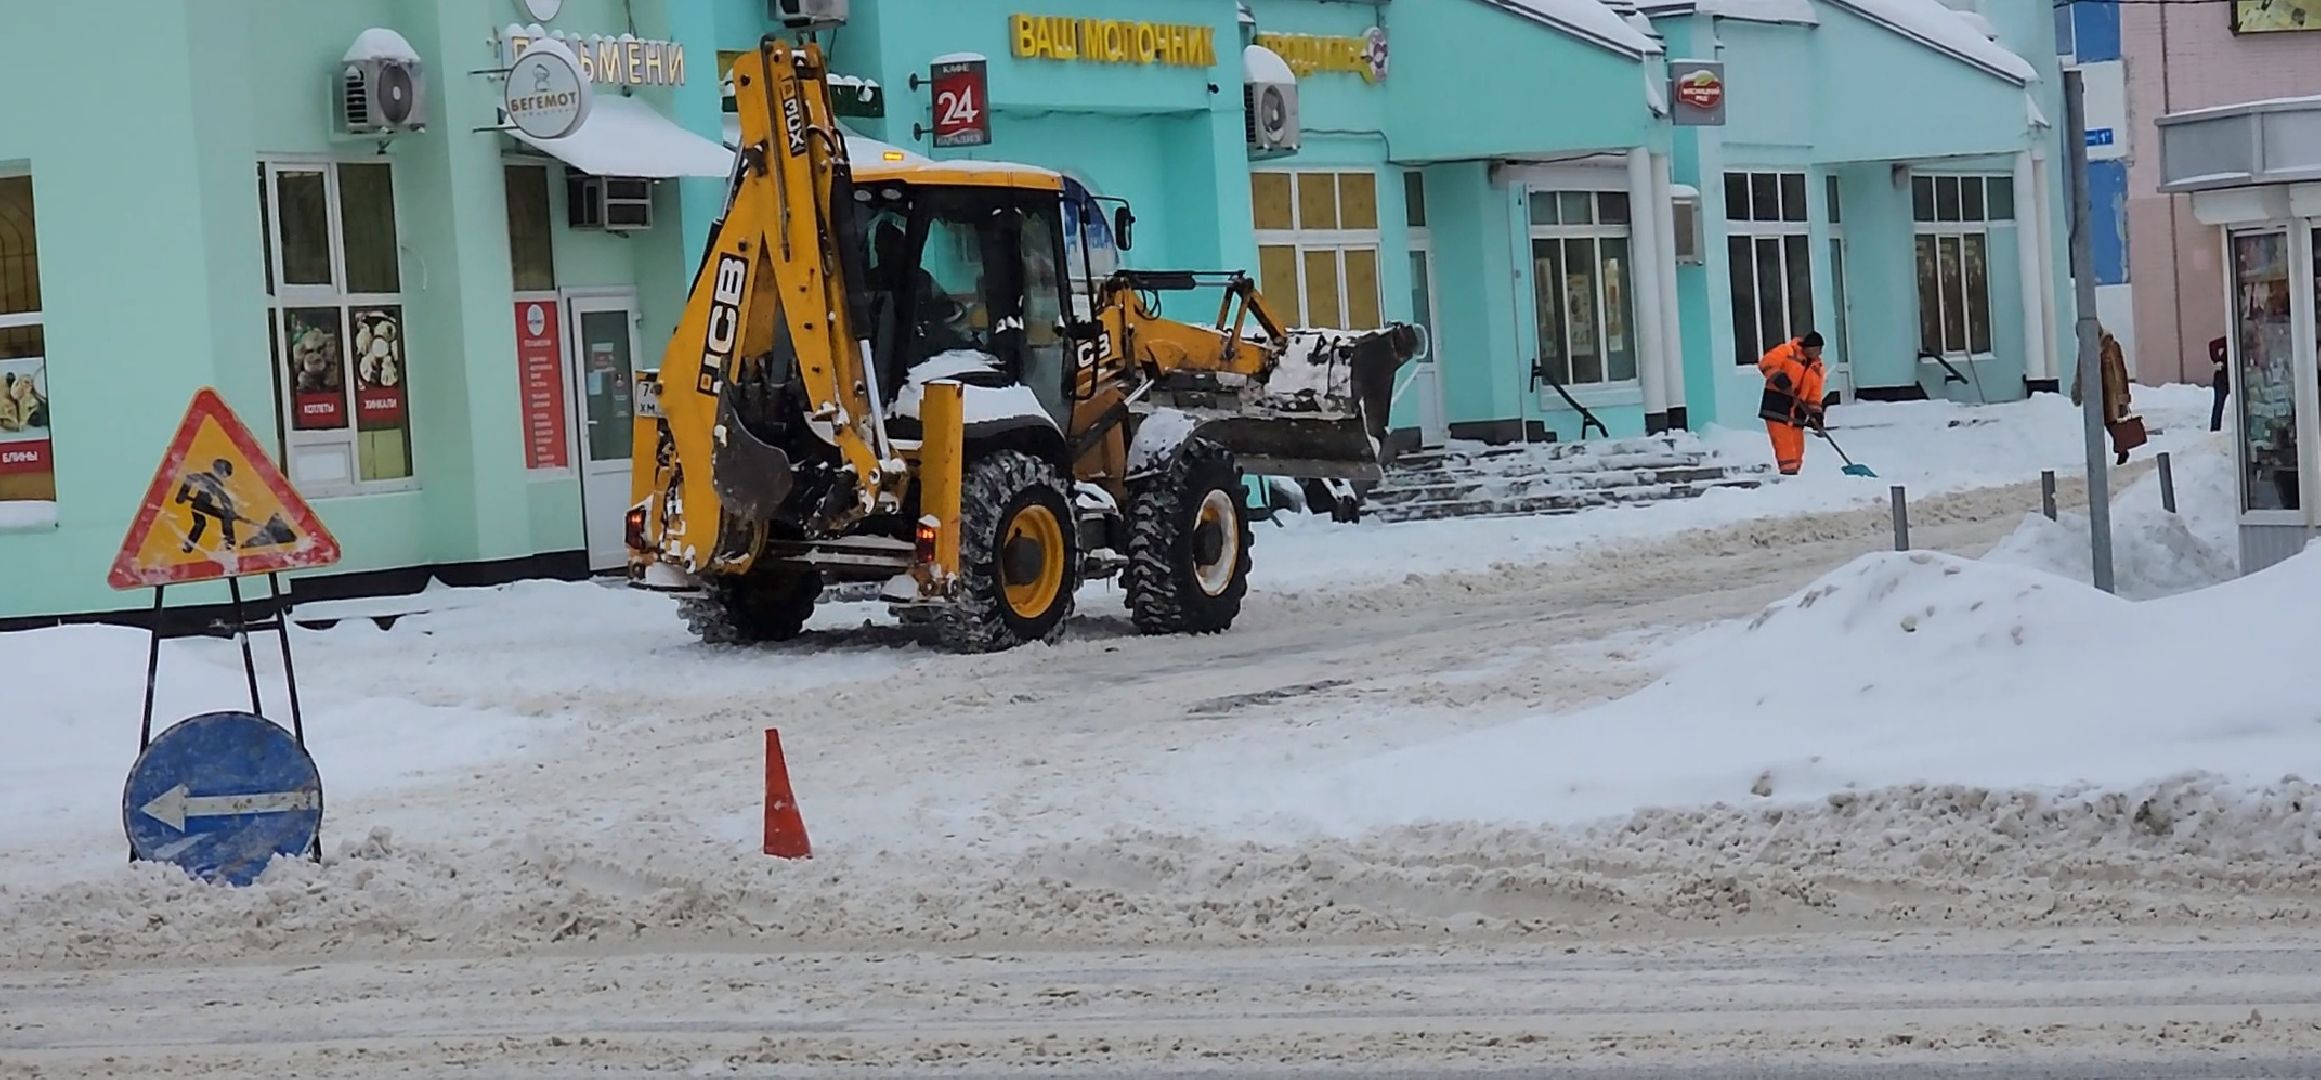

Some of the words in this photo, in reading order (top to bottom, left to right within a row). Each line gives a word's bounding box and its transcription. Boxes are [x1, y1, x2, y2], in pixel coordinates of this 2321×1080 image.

[511, 35, 686, 87] ПЬМЕНИ
[1009, 12, 1077, 60] ВАШ
[1078, 17, 1218, 67] МОЛОЧНИК
[510, 91, 578, 113] БЕГЕМОТ
[938, 84, 980, 126] 24
